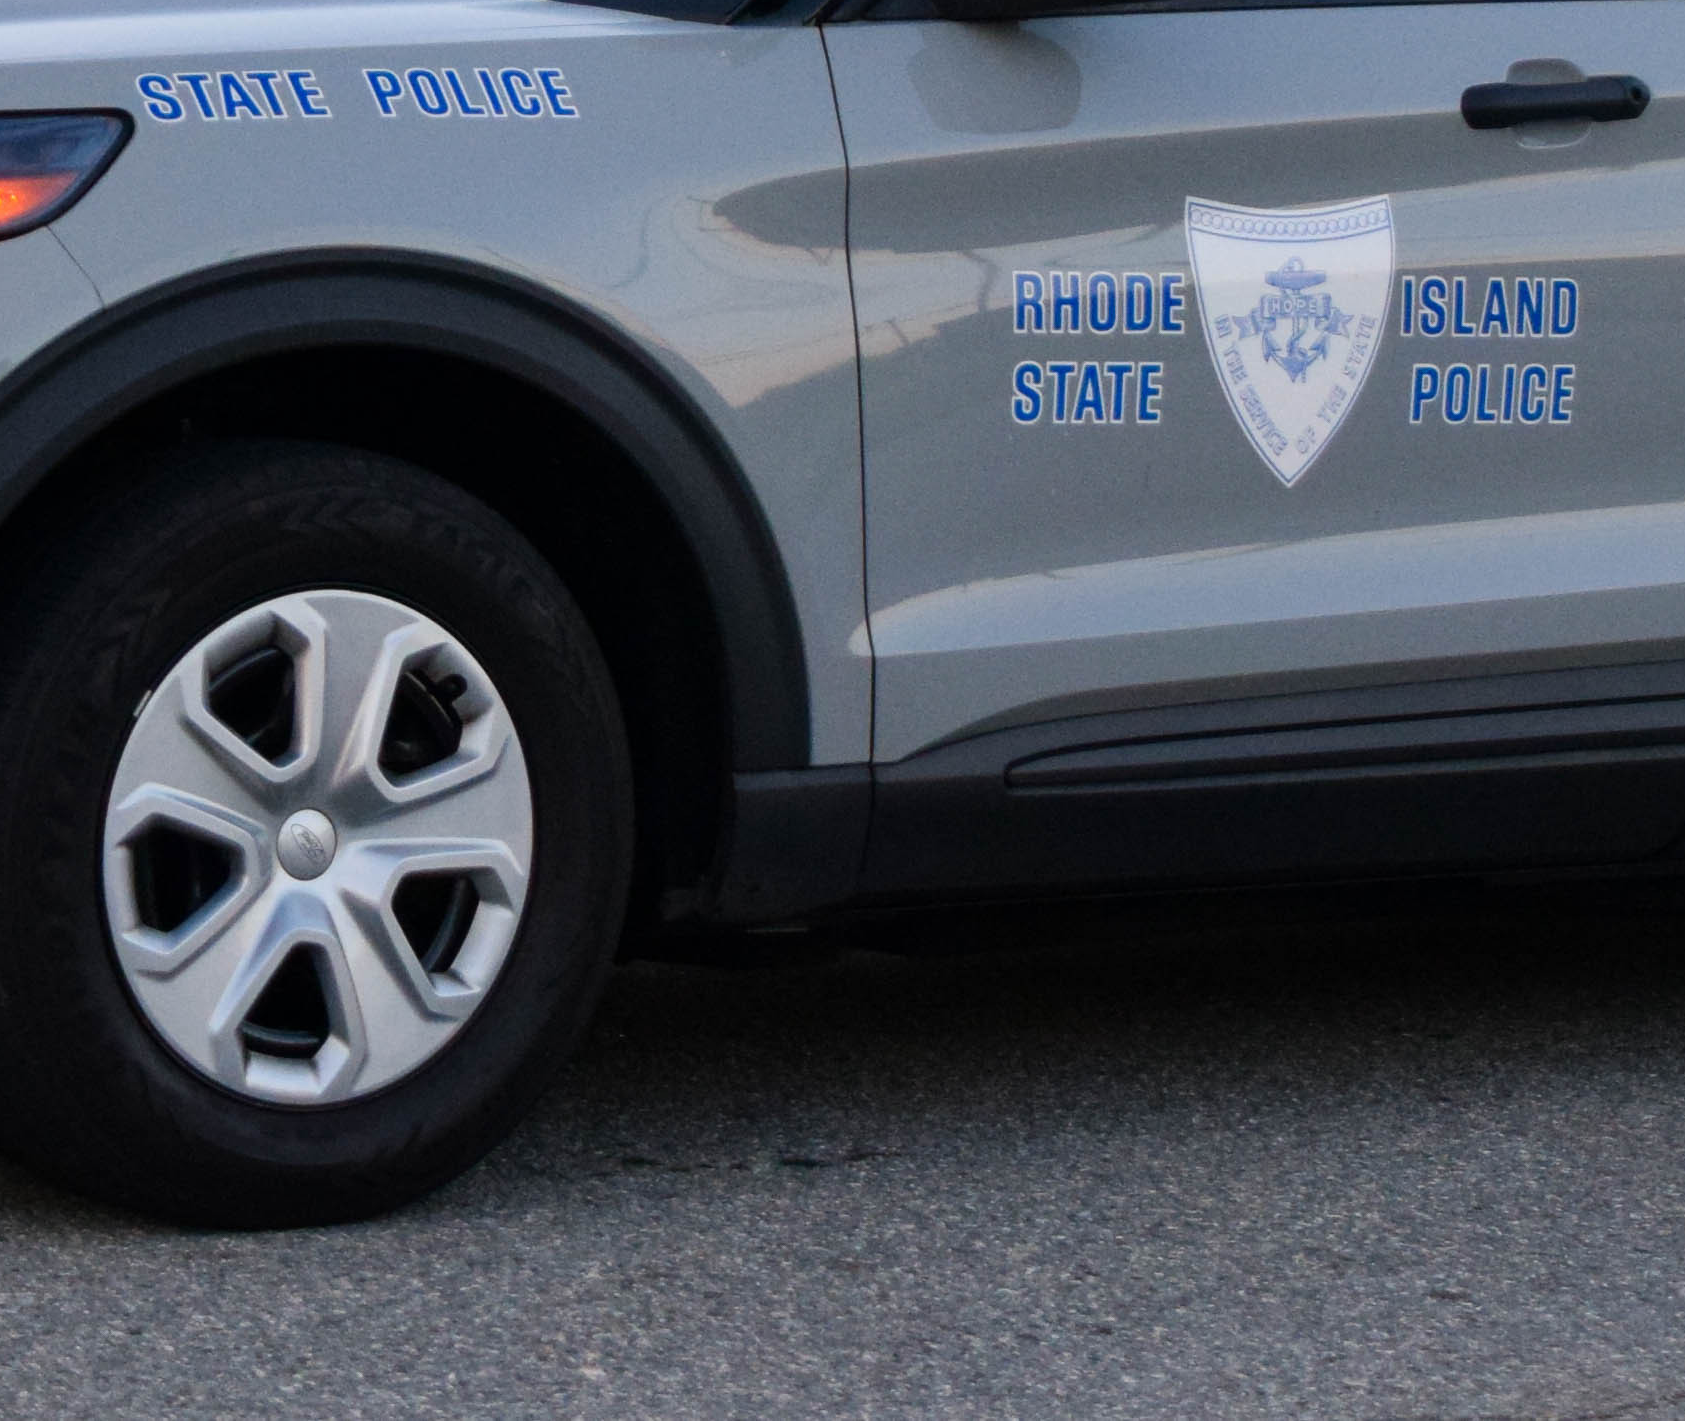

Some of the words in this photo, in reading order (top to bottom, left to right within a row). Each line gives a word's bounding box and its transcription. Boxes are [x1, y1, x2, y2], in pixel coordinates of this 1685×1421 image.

[136, 70, 332, 123] STATE
[362, 67, 580, 119] POLICE
[1012, 271, 1185, 335] RHODE
[1400, 276, 1579, 338] ISLAND
[1269, 297, 1318, 313] HOPE
[1012, 362, 1162, 425] STATE
[1409, 364, 1575, 425] POLICE
[1295, 427, 1317, 455] OF
[1317, 385, 1347, 424] THE
[1341, 315, 1377, 380] STATE
